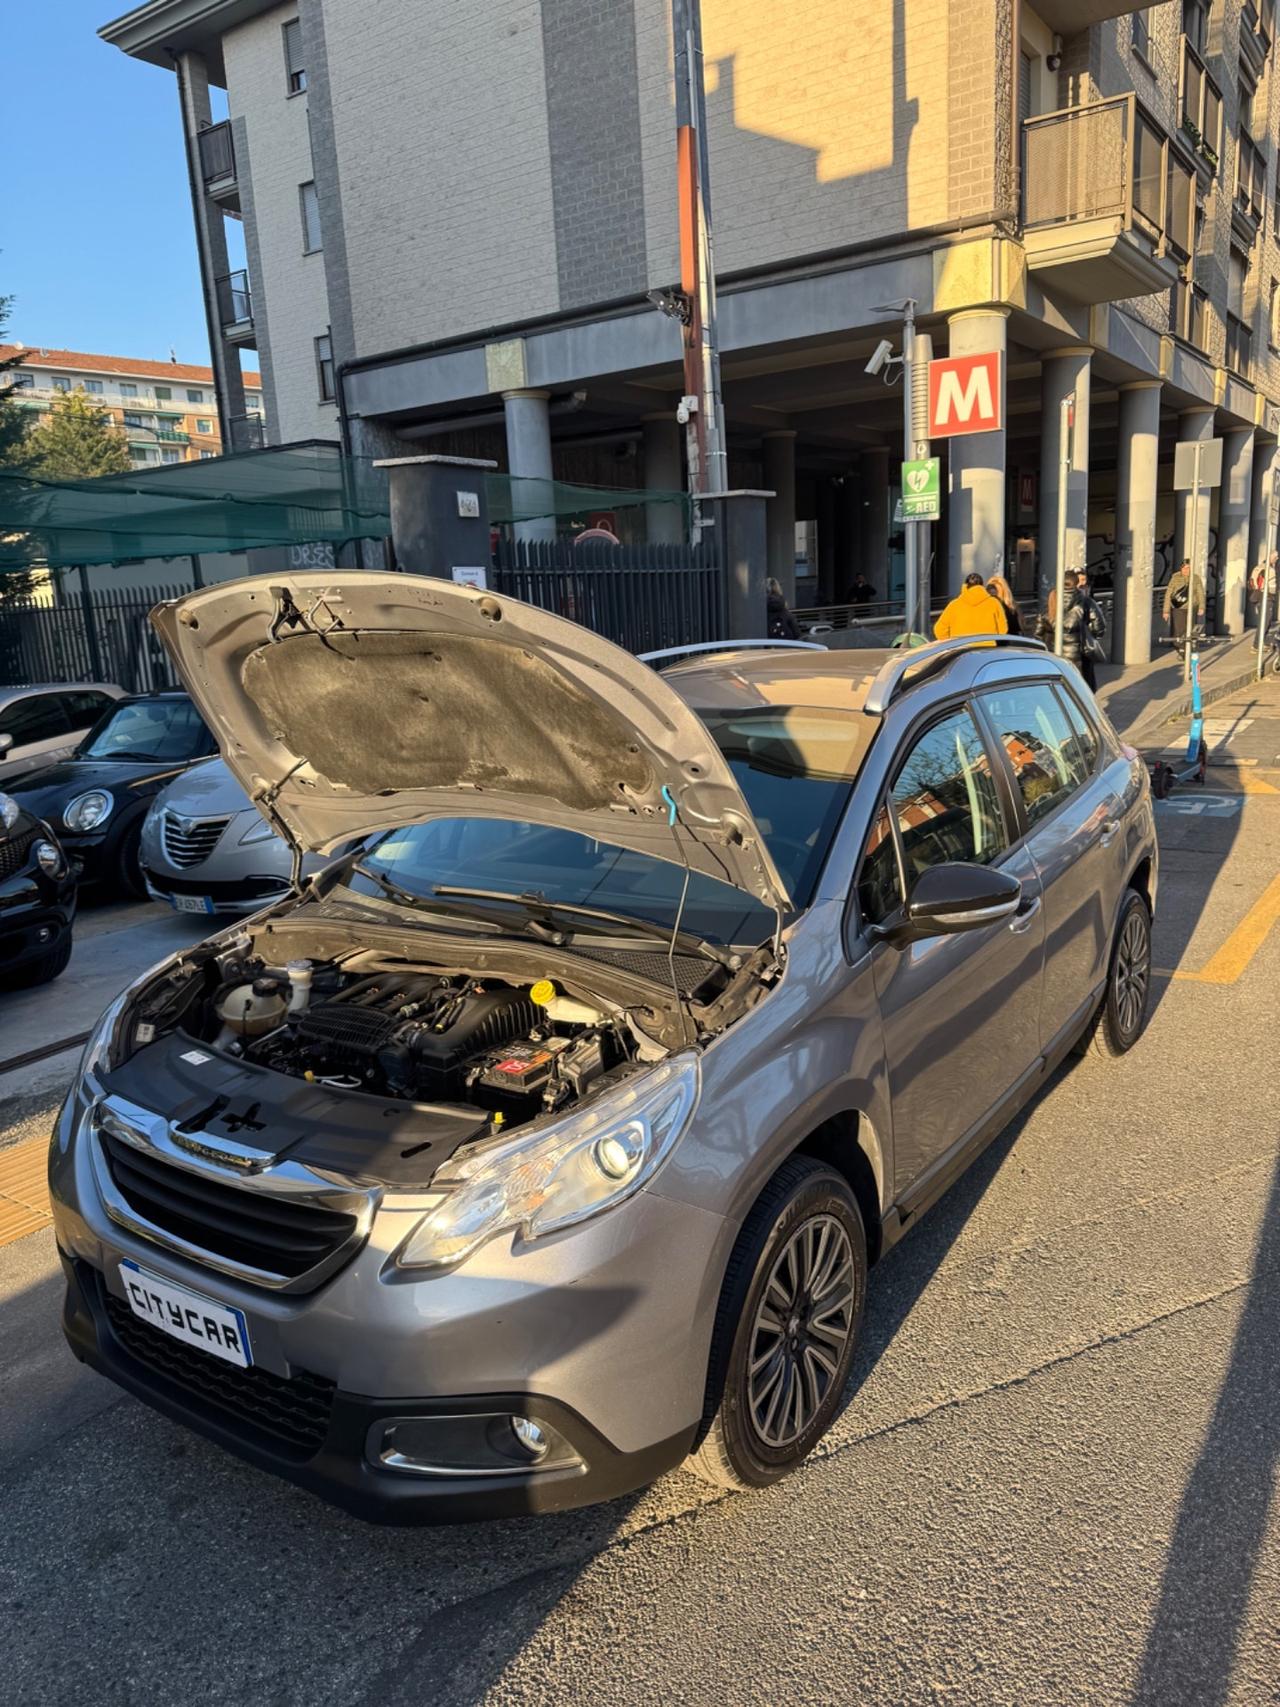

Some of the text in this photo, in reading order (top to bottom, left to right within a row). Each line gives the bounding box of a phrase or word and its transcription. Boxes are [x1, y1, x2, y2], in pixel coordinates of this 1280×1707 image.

[935, 365, 994, 426] M
[915, 501, 937, 514] AED
[129, 1281, 242, 1354] CITYCAR
